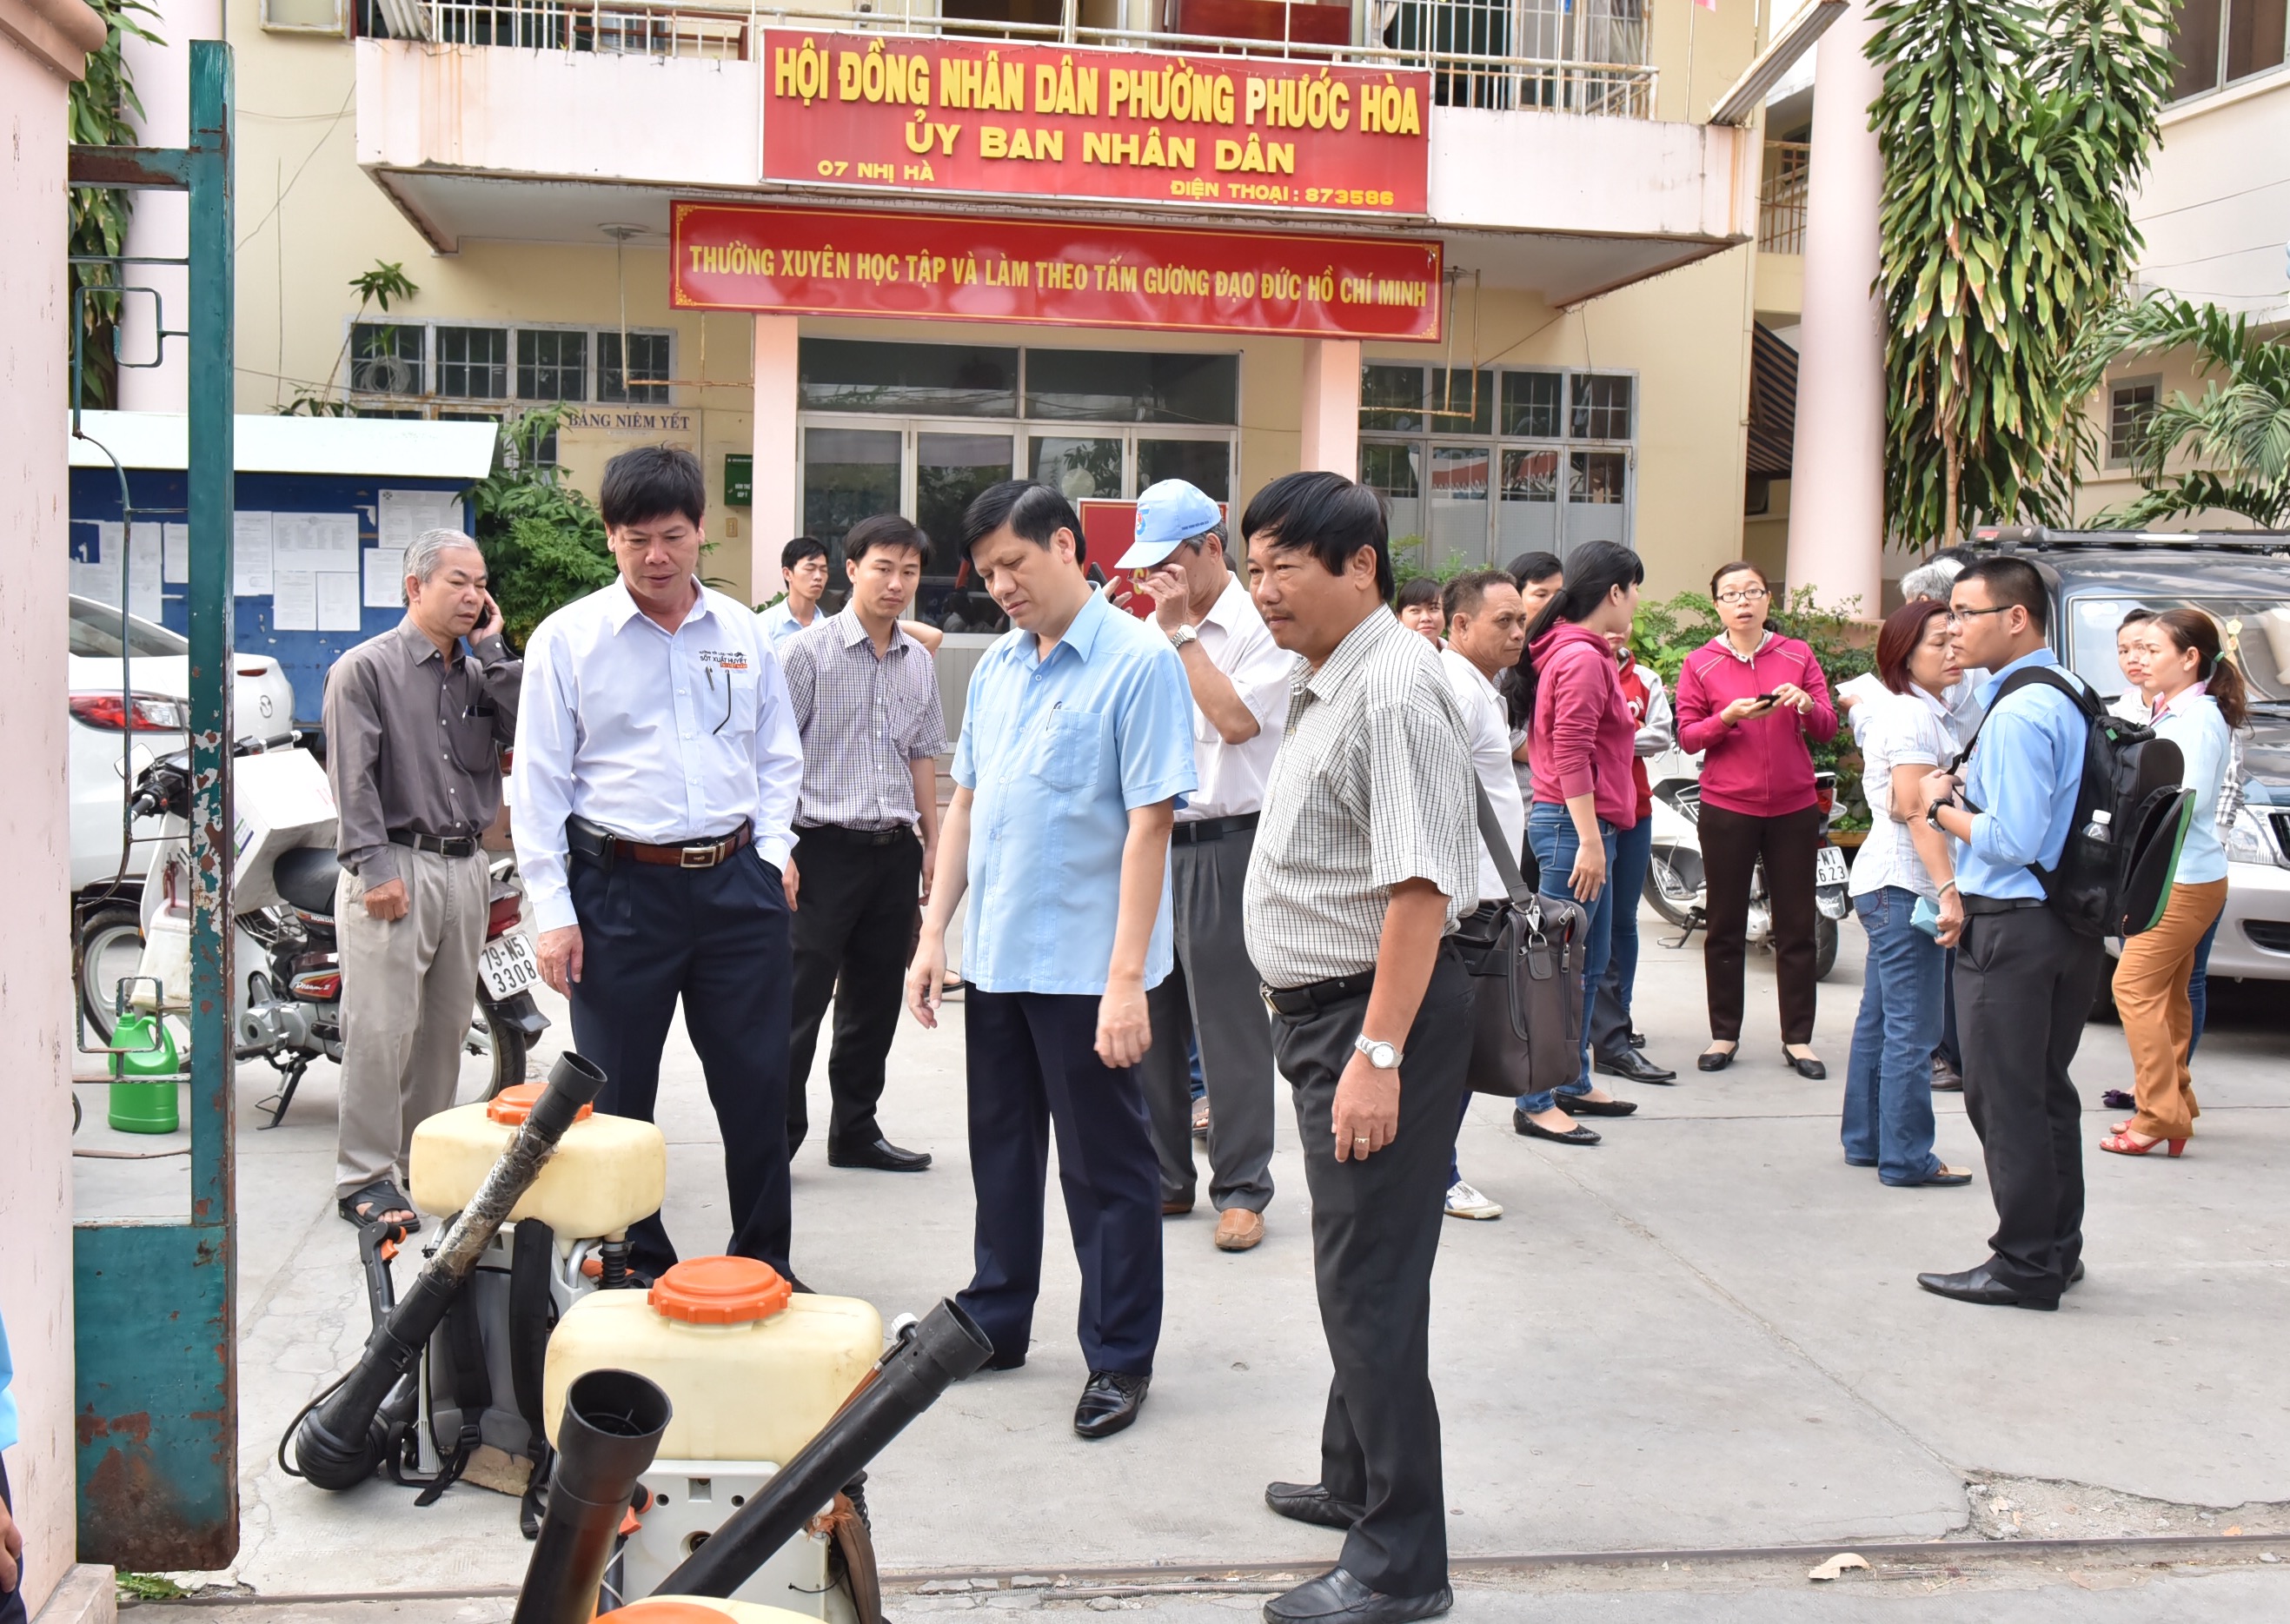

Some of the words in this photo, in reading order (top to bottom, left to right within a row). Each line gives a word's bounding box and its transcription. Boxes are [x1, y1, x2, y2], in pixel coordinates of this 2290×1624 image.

[774, 36, 829, 107] HỘI
[838, 36, 931, 106] ĐỒNG
[939, 50, 1025, 112] NHÂN
[1034, 54, 1099, 116] DÂN
[1108, 57, 1235, 125] PHƯỜNG
[1245, 67, 1350, 130] PHƯỚC
[1359, 72, 1421, 136] HÒA
[905, 109, 961, 156] ỦY
[979, 125, 1063, 162] BAN
[1083, 126, 1196, 169] NHÂN
[1215, 132, 1295, 175] DÂN
[817, 160, 848, 176] 07
[857, 162, 894, 183] NHỊ
[904, 159, 935, 182] HÀ
[1170, 176, 1219, 201] ĐIỆN
[1228, 182, 1289, 205] THOẠI
[1304, 188, 1395, 206] 873586
[689, 240, 774, 276] THƯỜNG
[780, 244, 850, 279] XUYÊN
[856, 253, 899, 286] HỌC
[905, 249, 946, 288] TẬP
[952, 250, 978, 285] VÀ
[985, 252, 1029, 287] LÀM
[1035, 261, 1088, 290] THEO
[1093, 255, 1138, 293] TẤM
[1144, 262, 1210, 296] GƯƠNG
[1215, 270, 1255, 303] ĐẠO
[1261, 266, 1302, 301] ĐỨC
[1307, 264, 1334, 302] HỒ
[1339, 272, 1371, 304] CHÍ
[1377, 279, 1427, 307] MINH
[568, 408, 611, 428] BẢNG
[616, 412, 656, 428] NIÊM
[660, 411, 690, 429] YẾT
[1817, 850, 1836, 865] -N1
[1818, 865, 1846, 883] 6.23
[310, 915, 335, 924] HONDA
[481, 937, 526, 971] 79-N5
[295, 981, 323, 991] Dream
[492, 959, 537, 992] 3308
